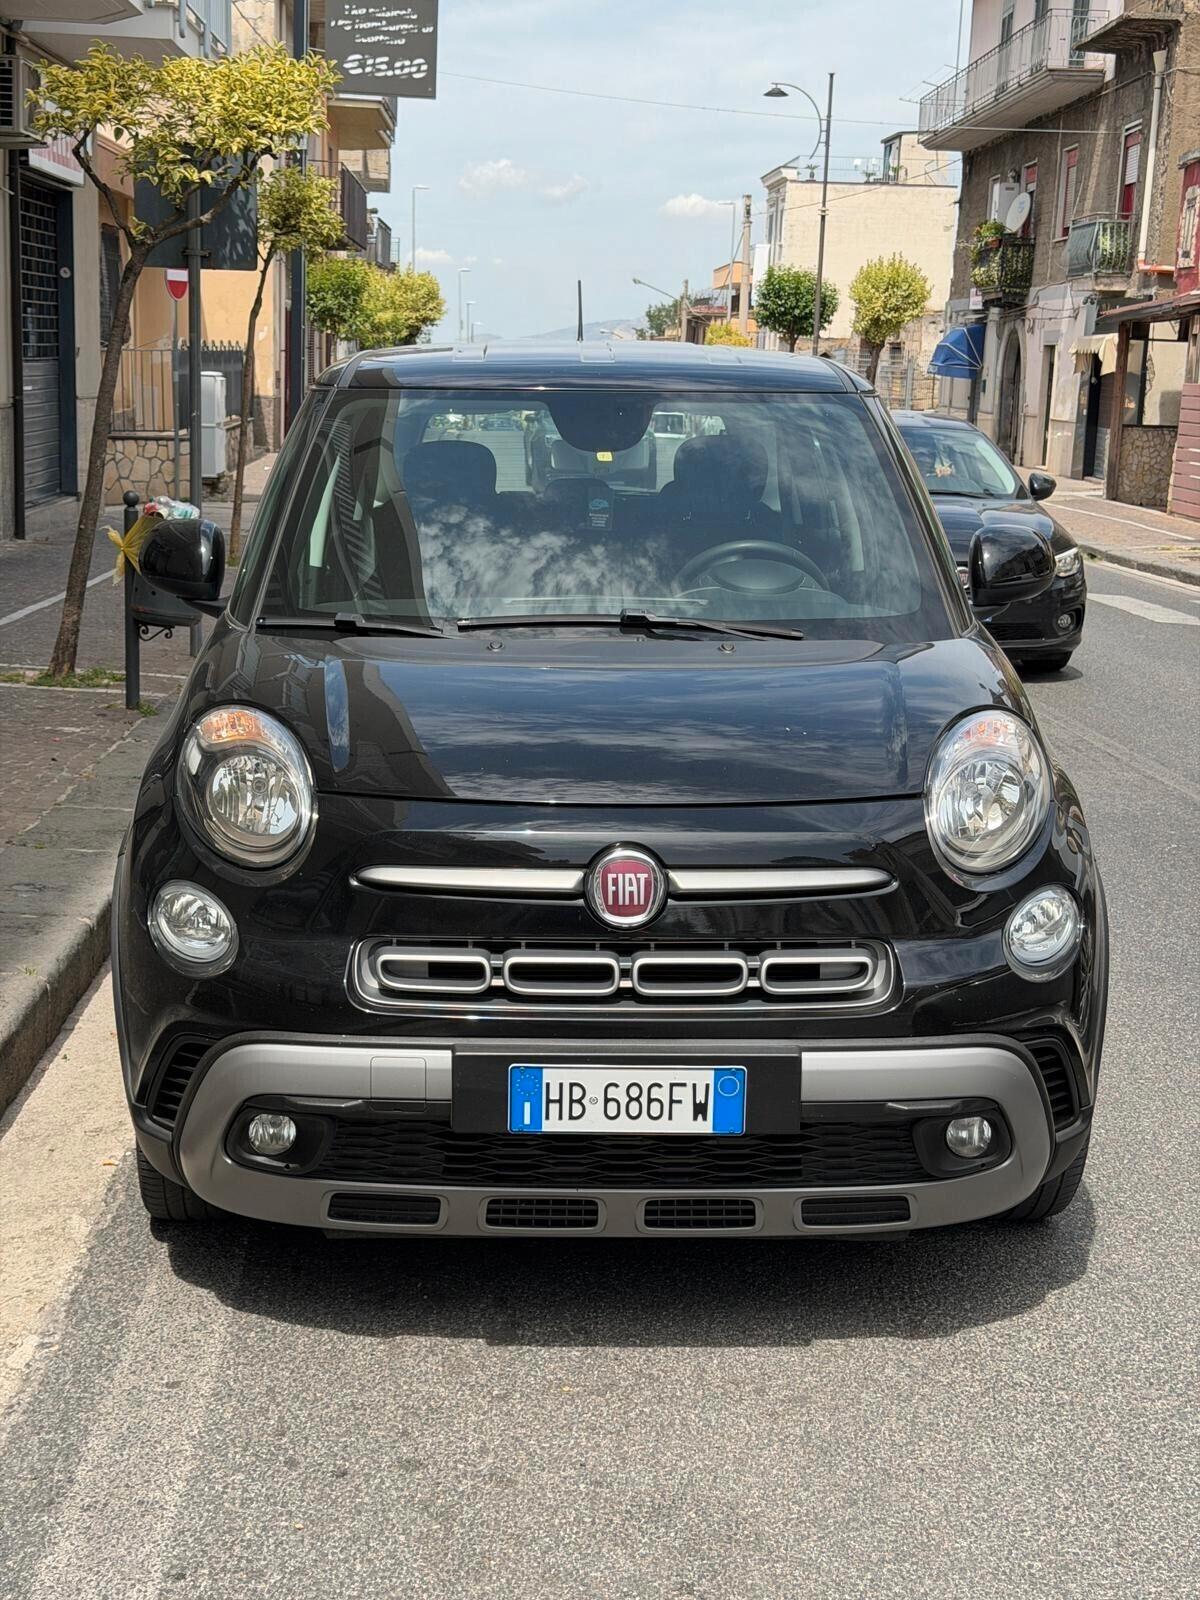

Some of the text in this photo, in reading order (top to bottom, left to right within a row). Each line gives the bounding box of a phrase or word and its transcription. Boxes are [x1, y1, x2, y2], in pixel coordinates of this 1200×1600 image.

[607, 873, 649, 906] FIAT
[544, 1081, 710, 1123] HB 686FW
